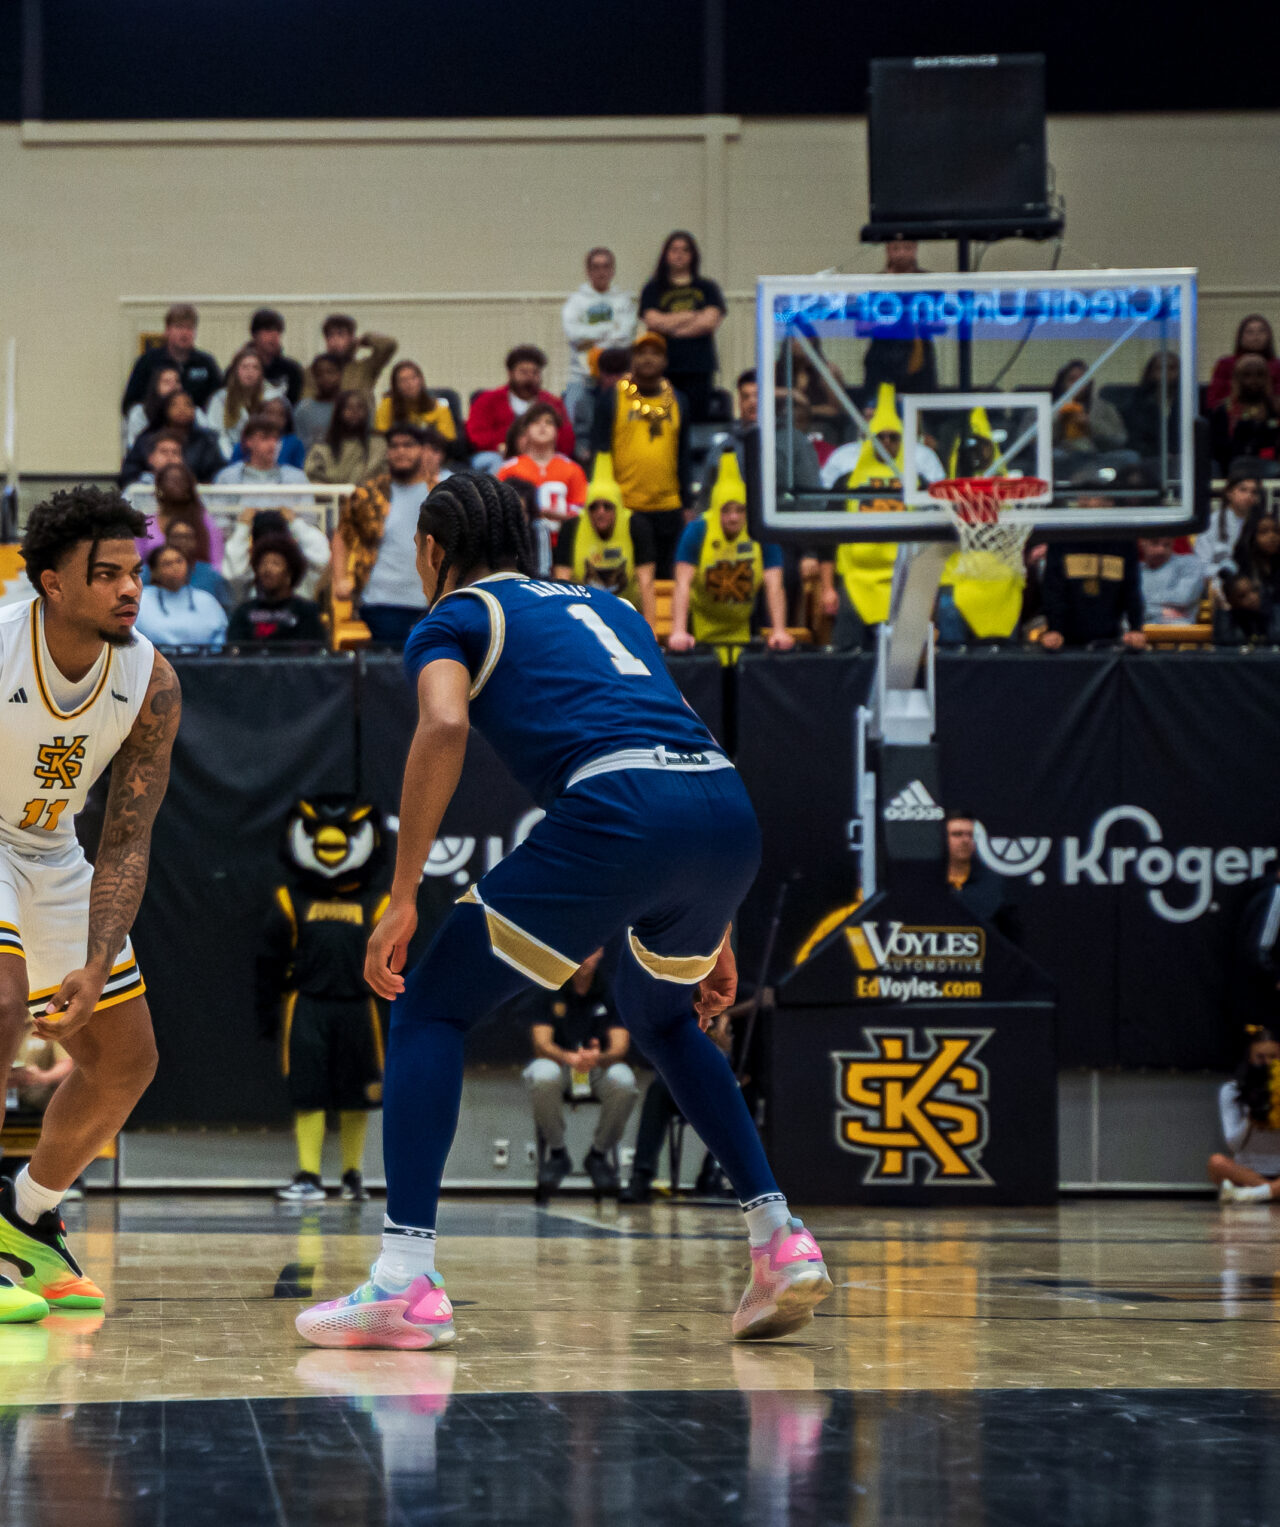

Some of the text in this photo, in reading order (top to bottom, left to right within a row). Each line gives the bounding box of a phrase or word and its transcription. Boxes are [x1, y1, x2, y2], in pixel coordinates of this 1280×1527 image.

[567, 603, 652, 676] 1
[19, 798, 70, 831] 11
[884, 806, 946, 821] adidas
[1063, 804, 1278, 923] Kroger
[882, 959, 984, 973] AUTOMOTIVE
[857, 976, 983, 1003] EdVoyles.com
